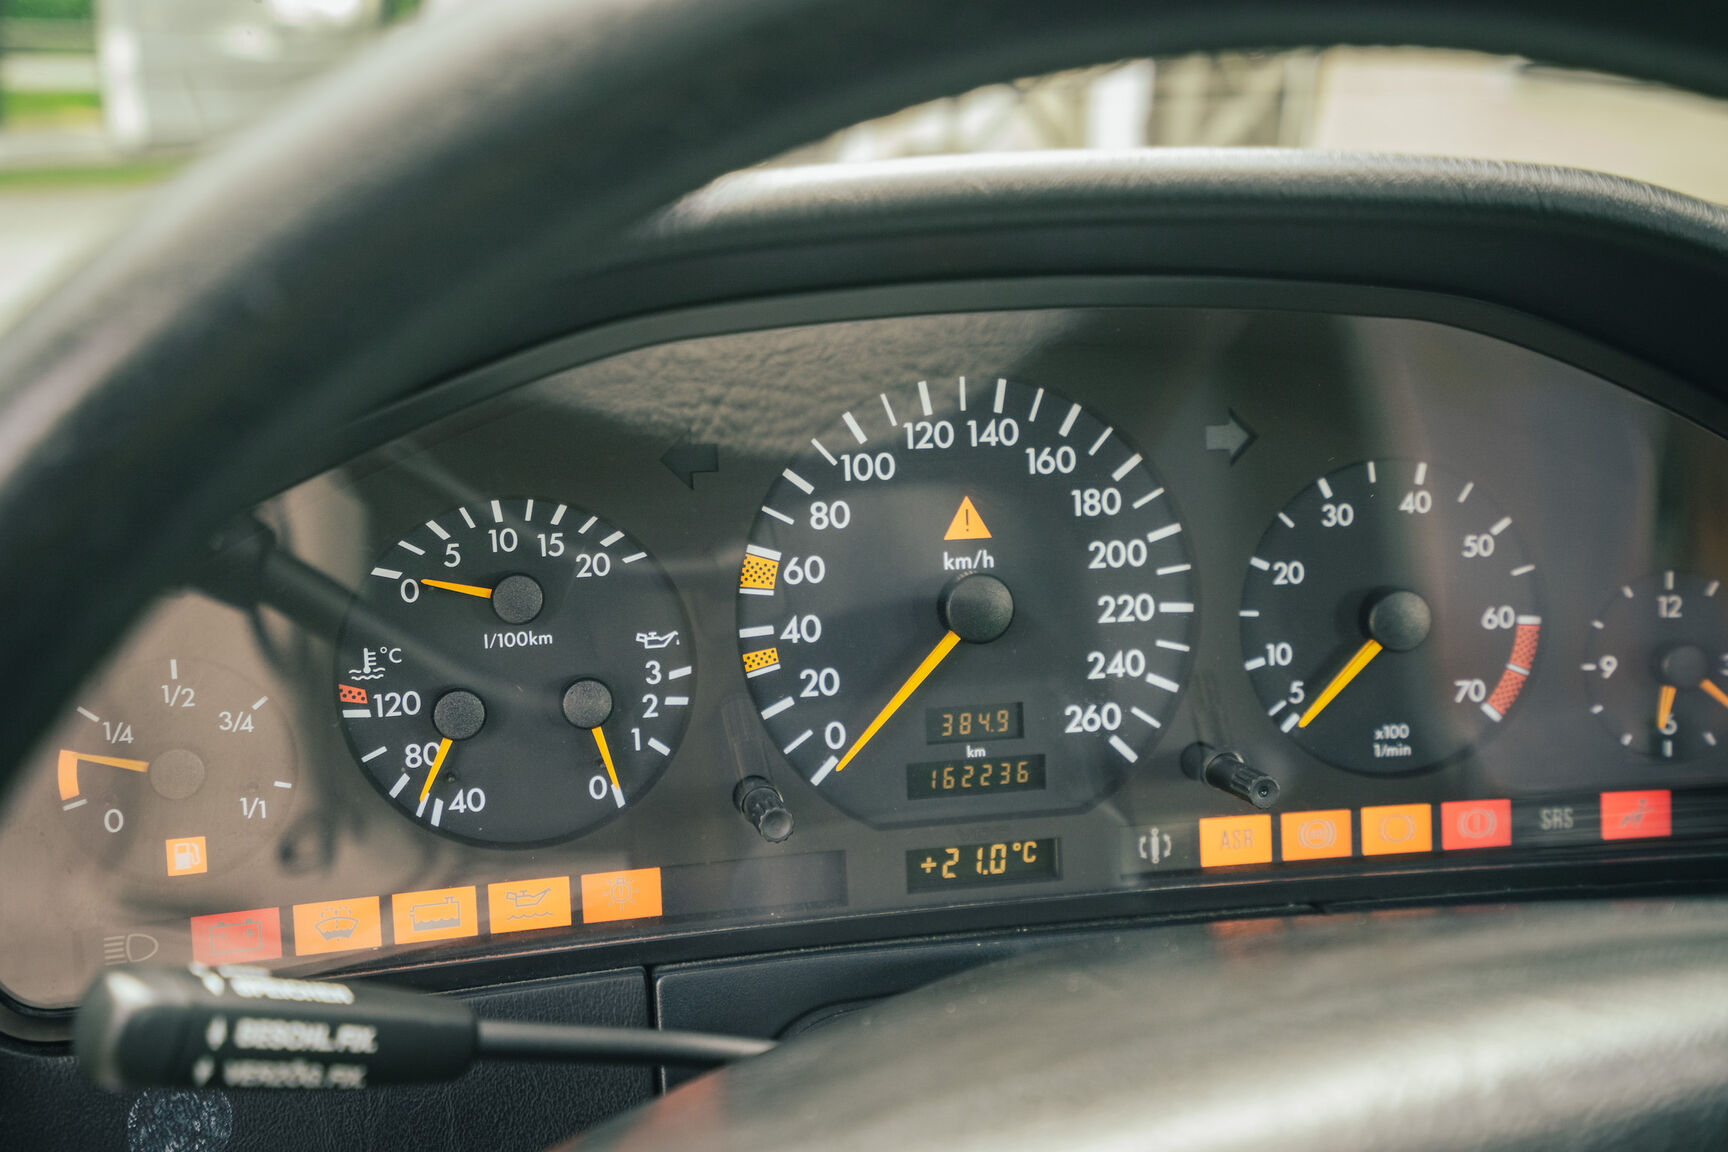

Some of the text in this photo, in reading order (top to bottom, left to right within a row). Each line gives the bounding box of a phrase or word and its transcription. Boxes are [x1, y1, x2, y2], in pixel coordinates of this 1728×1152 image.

[901, 420, 955, 450] 120
[966, 417, 1020, 448] 140
[839, 452, 896, 482] 100
[1025, 445, 1077, 475] 160
[1071, 487, 1122, 517] 180
[1399, 490, 1433, 514] 40
[809, 500, 851, 531] 80
[1321, 503, 1354, 528] 30
[487, 527, 518, 553] 10
[536, 532, 565, 557] 15
[1461, 533, 1495, 559] 50
[443, 542, 461, 568] 5
[575, 552, 611, 578] 20
[942, 549, 995, 571] km/h
[1088, 538, 1148, 570] 200
[783, 555, 826, 585] 60
[1272, 560, 1305, 586] 20
[400, 578, 420, 604] 0
[1097, 592, 1156, 624] 220
[1481, 605, 1516, 630] 60
[1657, 594, 1683, 619] 12
[779, 614, 822, 644] 40
[1087, 648, 1146, 680] 240
[1263, 642, 1293, 667] 10
[1599, 654, 1618, 679] 9
[645, 660, 662, 685] 3
[799, 667, 841, 698] 20
[161, 684, 196, 708] 1/2
[372, 690, 422, 718] 120
[1288, 680, 1305, 705] 5
[1454, 678, 1487, 704] 70
[641, 693, 659, 719] 2
[1064, 702, 1122, 734] 260
[102, 721, 135, 744] 1/4
[218, 711, 255, 733] 3/4
[941, 709, 1009, 737] 384.9
[630, 727, 641, 752] 1
[824, 721, 847, 750] 0
[404, 741, 441, 769] 80
[965, 744, 987, 758] km
[1373, 743, 1412, 758] 1/min
[588, 775, 608, 800] 0
[930, 760, 1030, 790] 162236
[239, 797, 267, 819] 1/1
[448, 787, 486, 814] 40
[103, 808, 124, 833] 0
[1540, 807, 1574, 830] SRS
[1219, 828, 1255, 851] ASR
